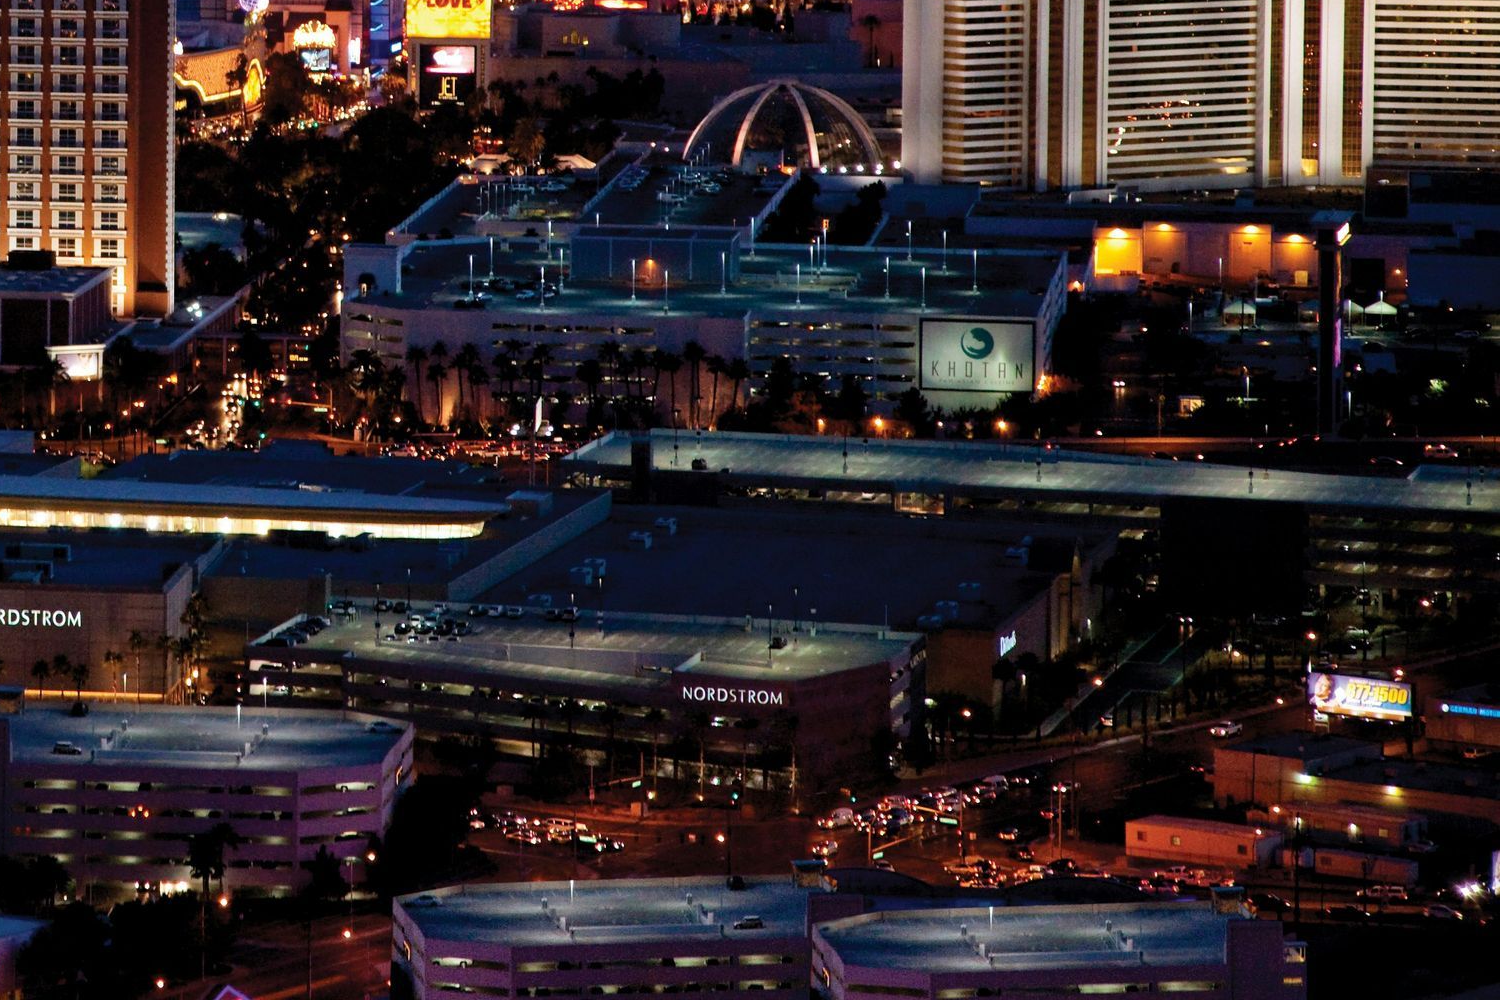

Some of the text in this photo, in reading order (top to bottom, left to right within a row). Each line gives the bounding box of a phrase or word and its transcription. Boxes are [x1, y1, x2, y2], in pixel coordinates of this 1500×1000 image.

[439, 76, 458, 97] JET
[931, 360, 1024, 379] KHOTAN
[683, 686, 783, 705] NORDSTROM
